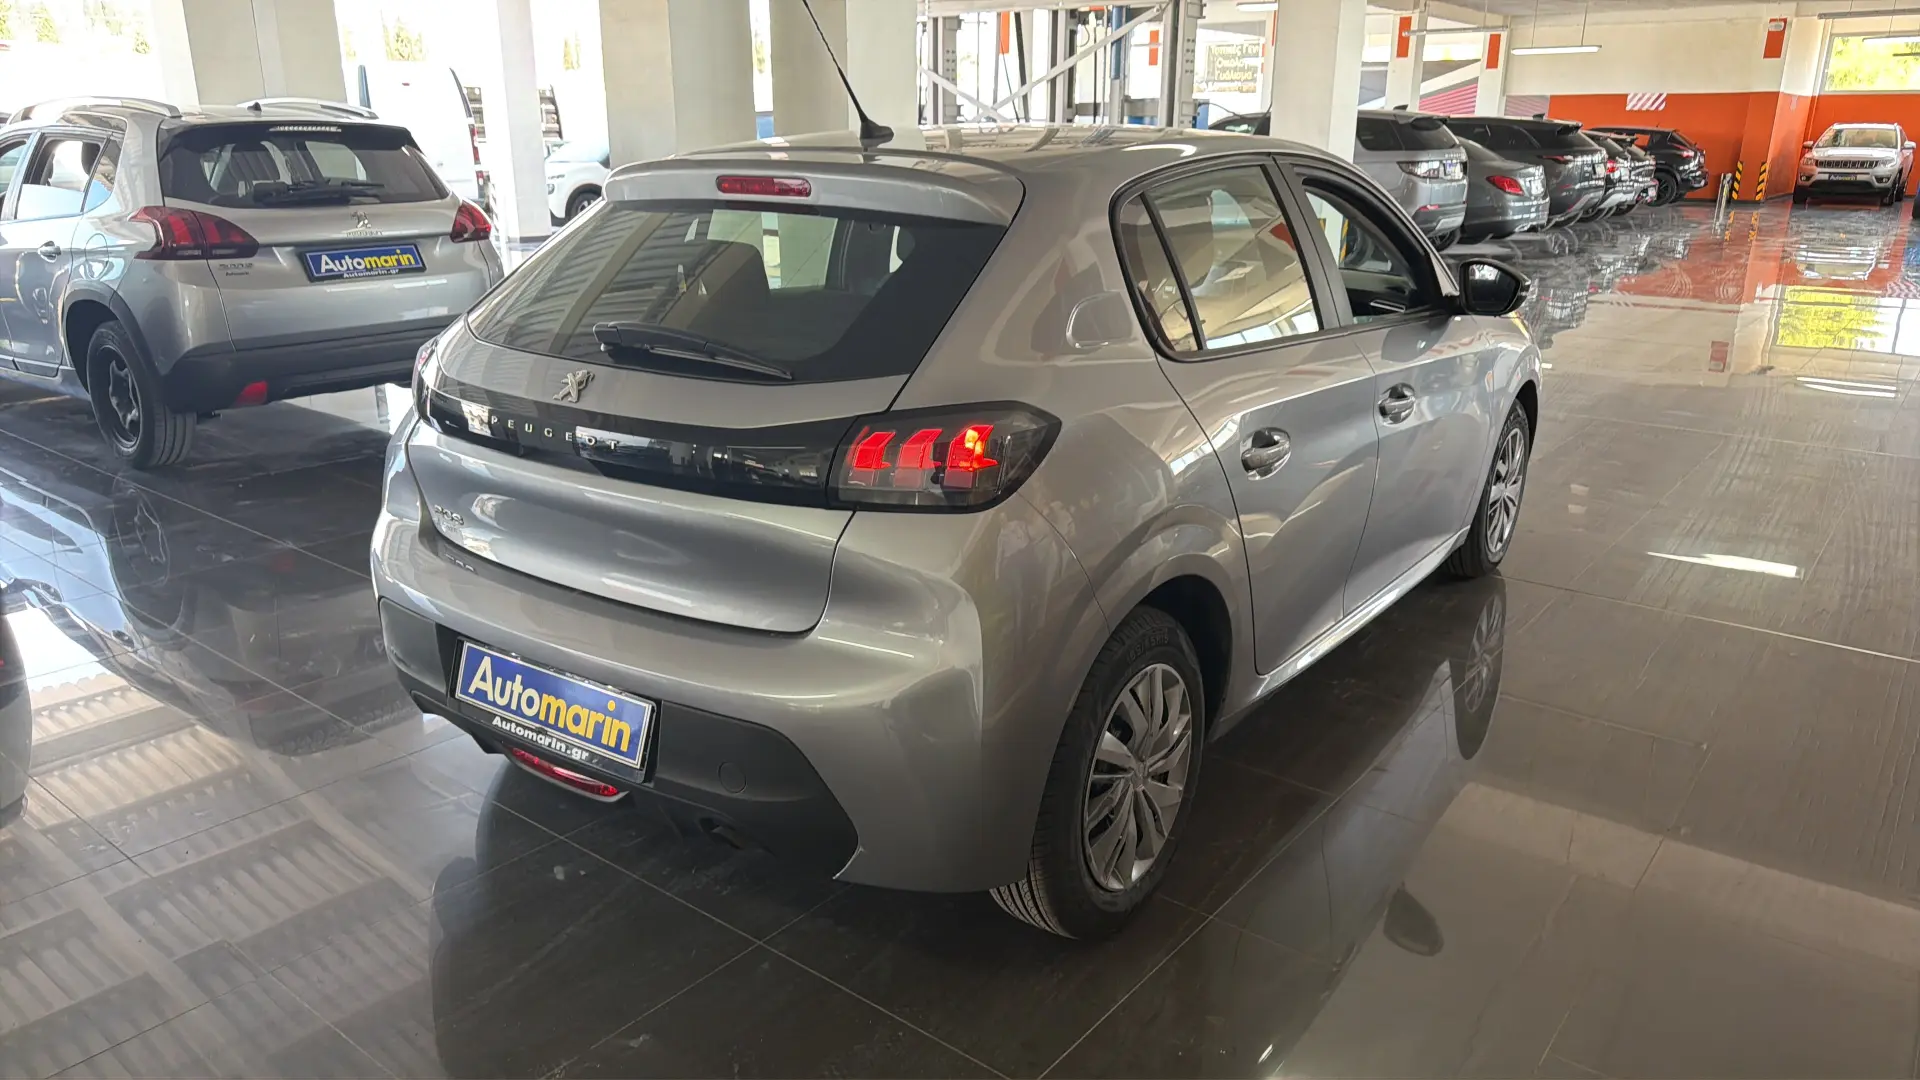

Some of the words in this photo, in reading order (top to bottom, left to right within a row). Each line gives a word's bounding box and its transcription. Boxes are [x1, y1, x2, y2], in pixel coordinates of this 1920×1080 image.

[320, 248, 415, 274] Automarin
[343, 267, 400, 279] Automarin.gr
[490, 415, 620, 450] PEUGEOT
[468, 655, 631, 753] Automarin
[491, 716, 590, 761] Automarin.gr
